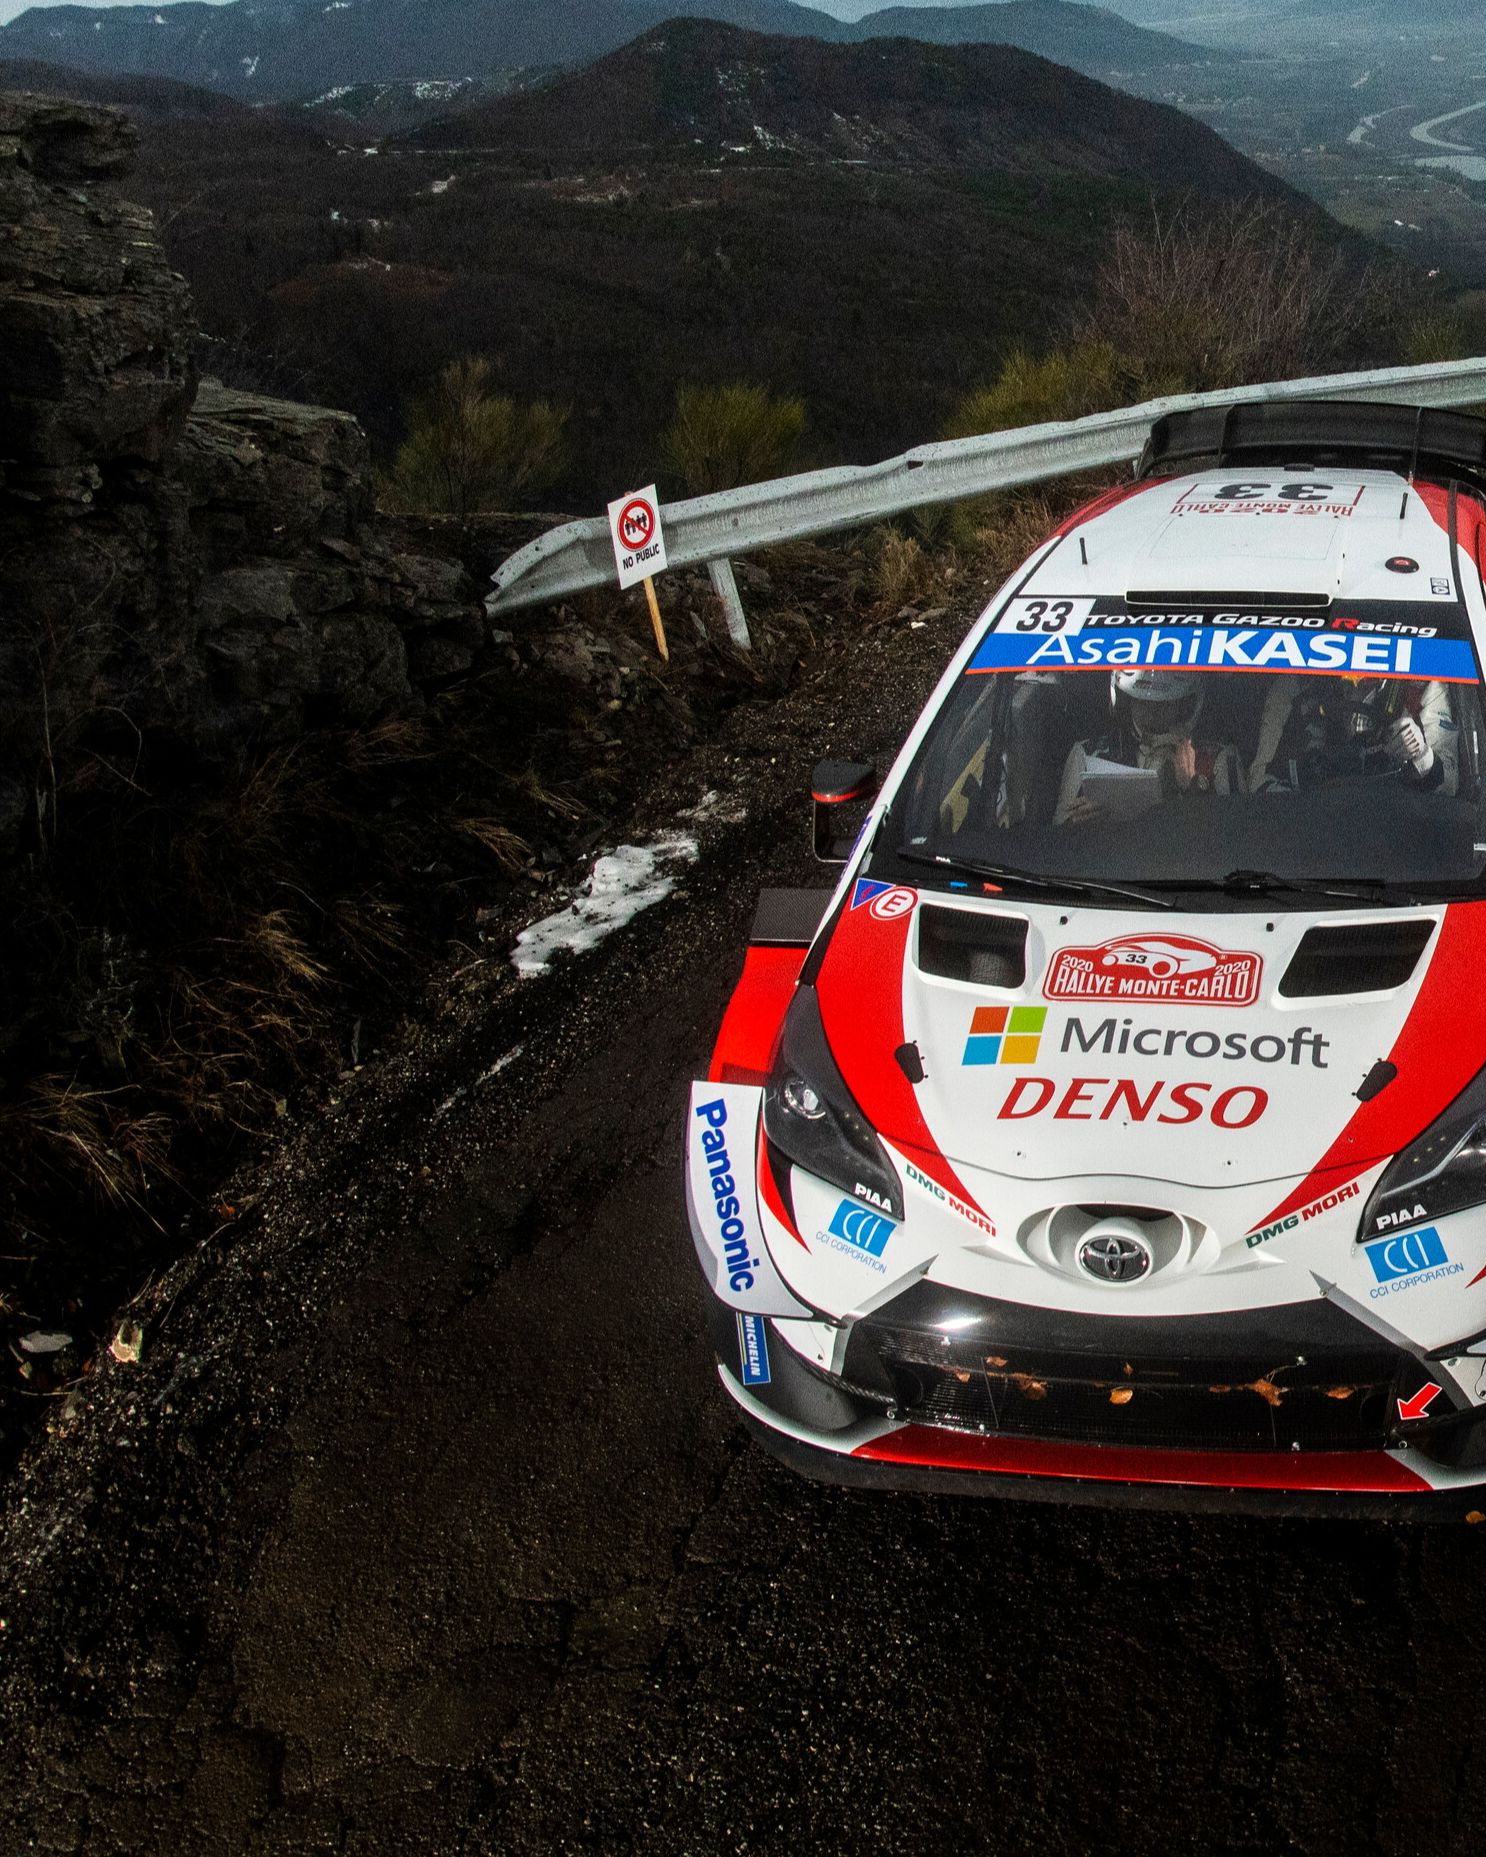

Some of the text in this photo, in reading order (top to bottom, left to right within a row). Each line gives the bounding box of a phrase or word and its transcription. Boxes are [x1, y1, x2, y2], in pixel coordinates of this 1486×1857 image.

[1214, 483, 1334, 500] 33
[622, 543, 660, 571] NO PUBLIC
[1016, 601, 1074, 632] 33
[1086, 613, 1438, 639] TOYOTA GAZOO Racing
[881, 894, 908, 912] E
[1061, 954, 1094, 973] 2020
[1125, 953, 1148, 964] 33
[1214, 959, 1251, 976] 2020
[1053, 964, 1250, 999] RALLYE MONTE-CARLO
[1060, 1017, 1330, 1069] Microsoft
[996, 1077, 1269, 1129] DENSO
[696, 1098, 760, 1293] Panasonic
[854, 1182, 892, 1213] PIAA
[906, 1164, 996, 1238] DMG MORI
[1246, 1182, 1360, 1249] DMG MORI
[1376, 1203, 1428, 1231] PIAA
[815, 1231, 887, 1274] CCI CORPORATION
[1369, 1263, 1465, 1299] CCI CORPORATION
[744, 1315, 761, 1376] MICHELIN
